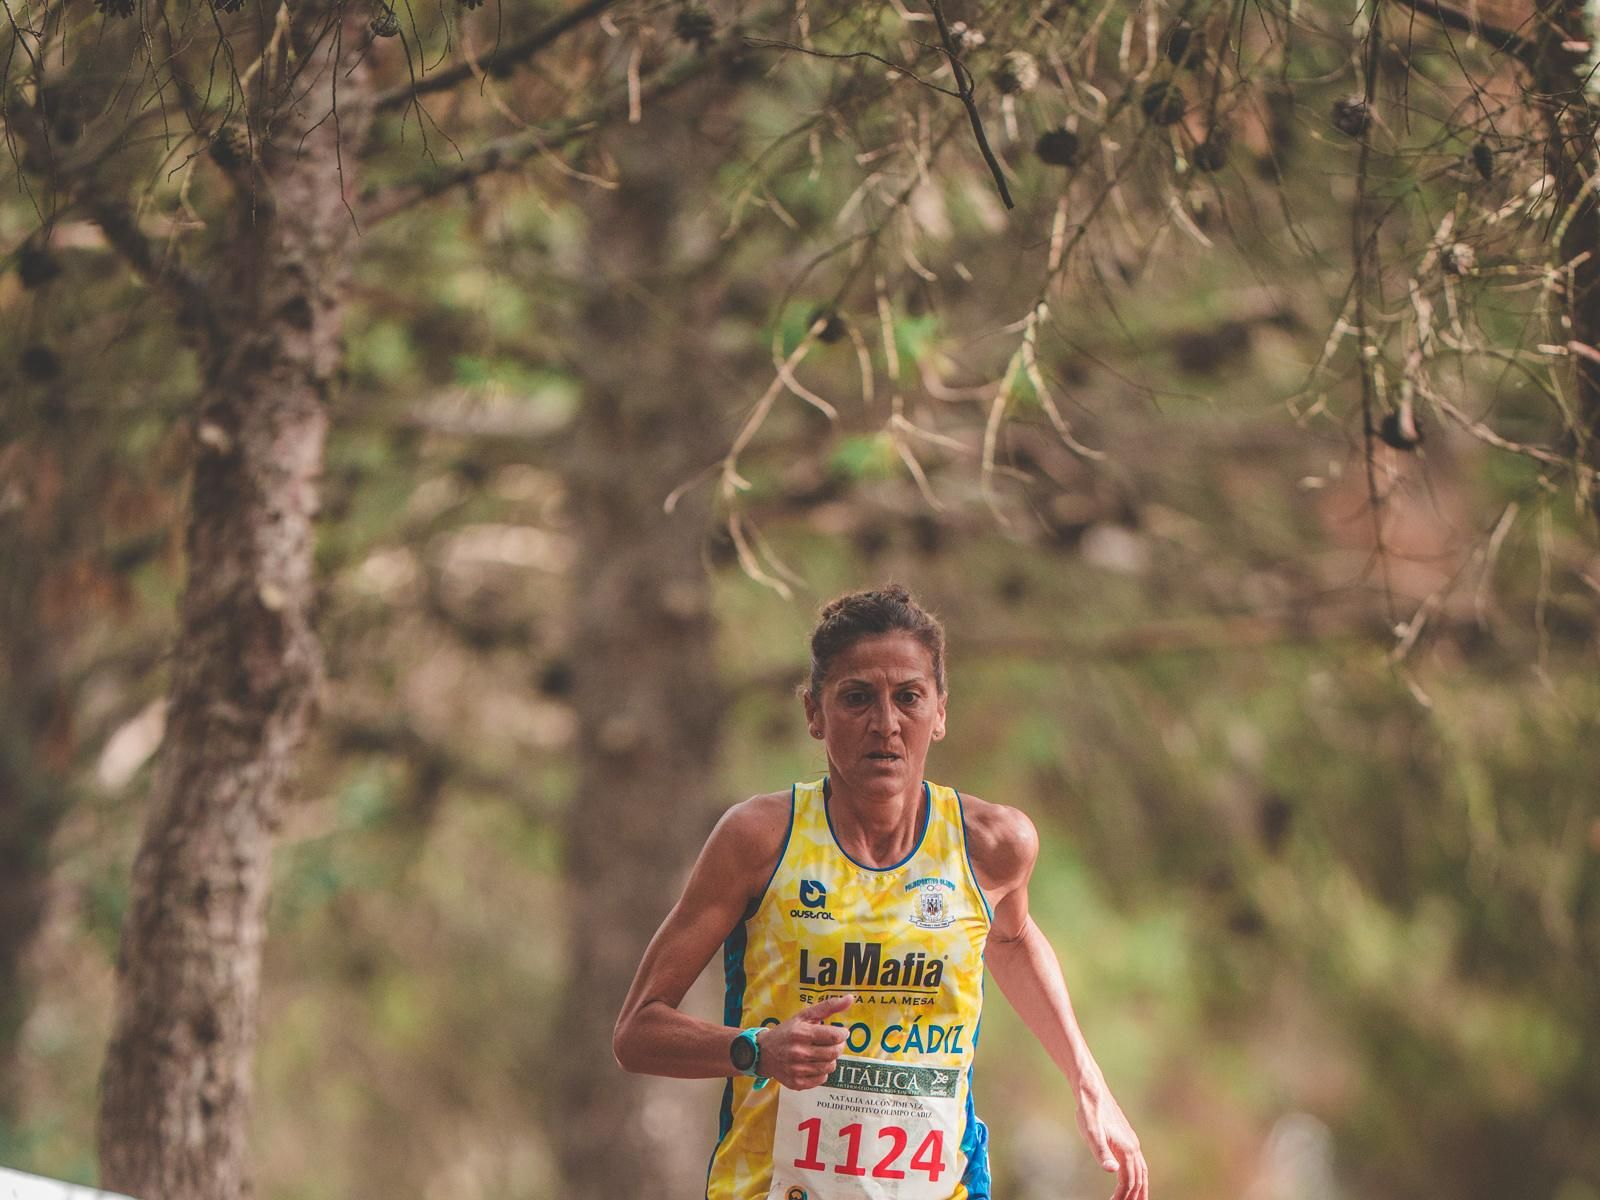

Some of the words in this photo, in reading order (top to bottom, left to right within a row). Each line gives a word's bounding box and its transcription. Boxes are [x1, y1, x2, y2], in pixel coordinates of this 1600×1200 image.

[800, 994, 813, 1004] SE
[867, 996, 876, 1004] A
[880, 996, 897, 1005] LA
[901, 996, 935, 1006] MESA
[880, 1015, 964, 1054] CÁDIZ
[838, 1065, 920, 1090] ITÁLICA
[816, 1101, 880, 1115] POLIDEPORTIVO
[880, 1107, 910, 1117] OLIMPO
[794, 1117, 946, 1182] 1124
